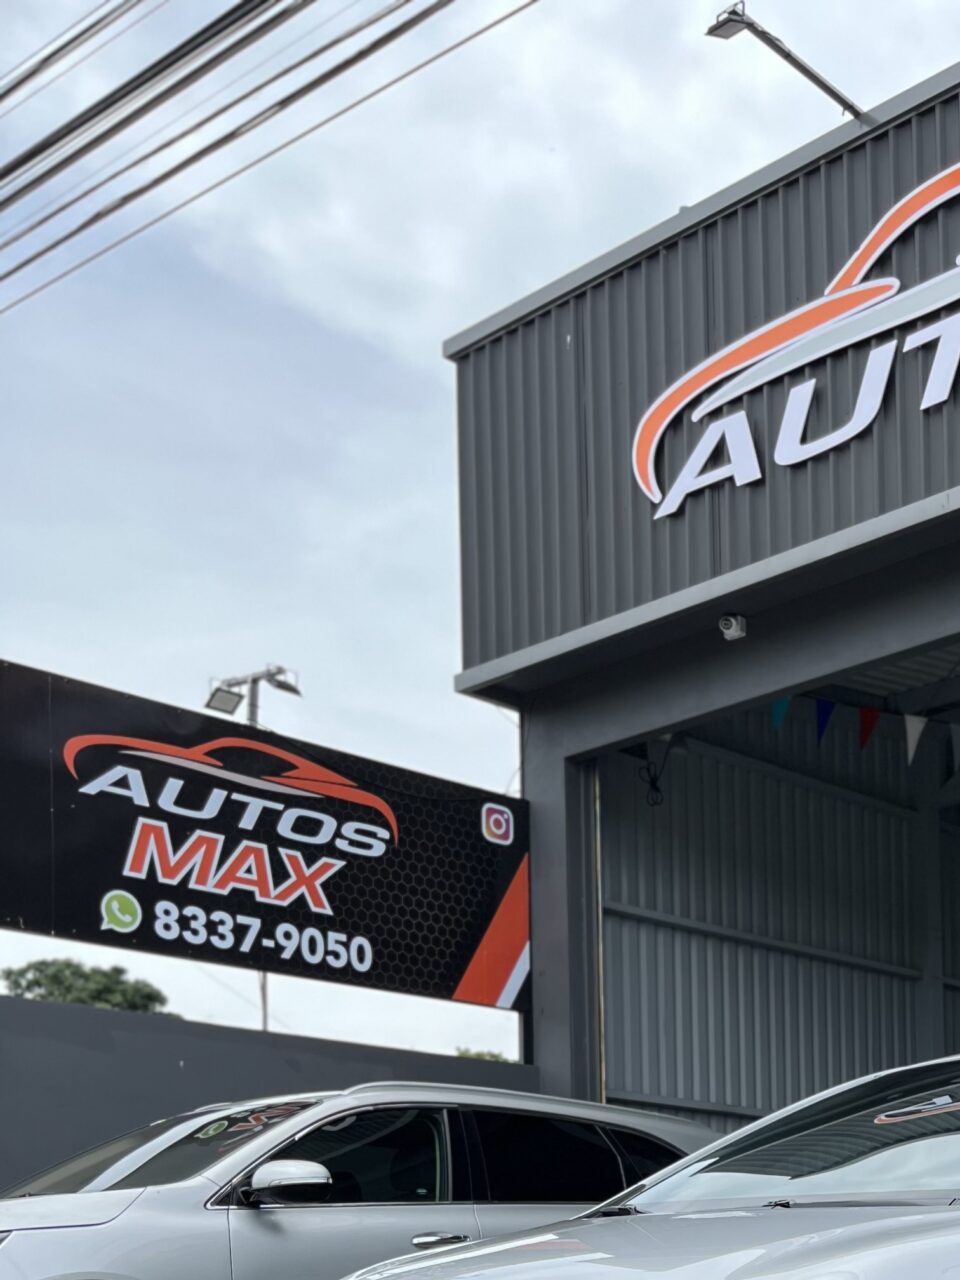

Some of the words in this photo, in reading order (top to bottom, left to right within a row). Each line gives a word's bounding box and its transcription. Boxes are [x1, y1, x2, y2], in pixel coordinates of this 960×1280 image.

[79, 765, 391, 857] AUTOS
[122, 816, 347, 916] MAX
[153, 901, 374, 972] 8337-9050
